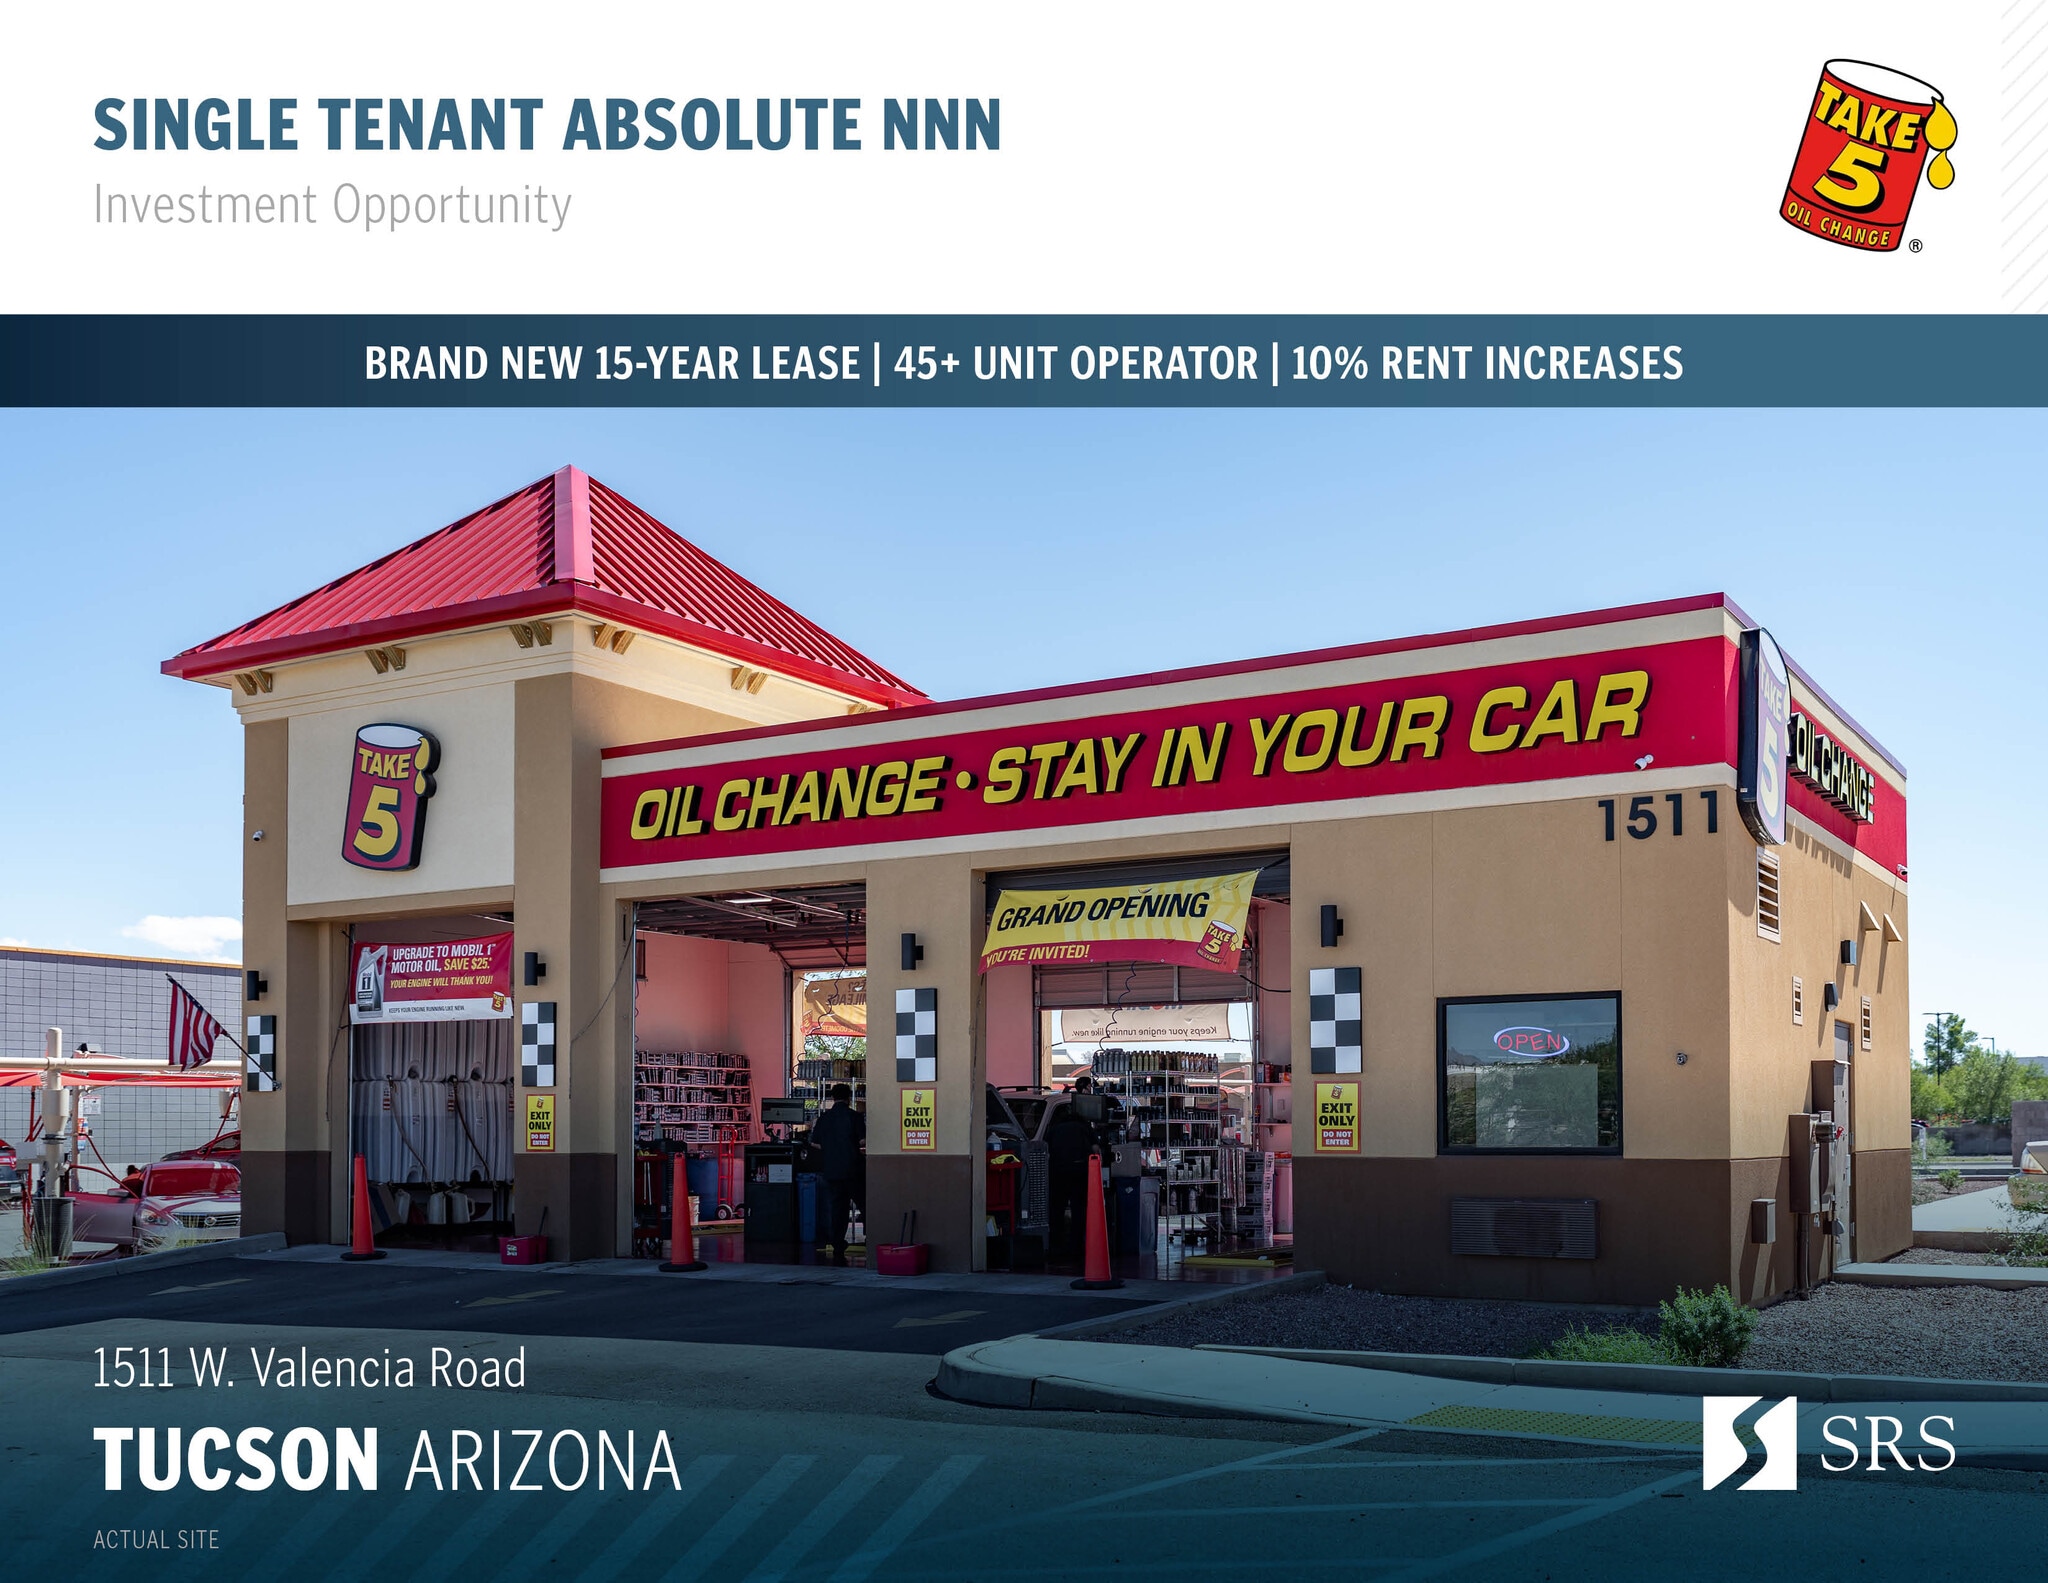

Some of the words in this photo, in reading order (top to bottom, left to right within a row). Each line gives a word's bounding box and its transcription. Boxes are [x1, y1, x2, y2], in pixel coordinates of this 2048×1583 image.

[1759, 661, 1782, 722] TAKE
[358, 747, 412, 780] TAKE
[630, 785, 704, 840] OIL
[712, 755, 948, 832] CHANGE
[982, 732, 1143, 804] STAY
[1152, 722, 1229, 788] IN
[1249, 695, 1450, 776] YOUR
[1468, 670, 1650, 754] CAR
[1760, 716, 1780, 819] 5
[1796, 711, 1819, 784] OIL
[1820, 734, 1875, 825] CHANGE
[353, 784, 402, 858] 5
[1598, 790, 1718, 842] 1511
[996, 900, 1086, 932] GRAND
[1087, 892, 1210, 921] OPENING
[1207, 925, 1231, 943] TAKE
[393, 946, 435, 961] UPGRADE
[436, 945, 449, 958] TO
[450, 944, 484, 957] MOBIL
[1204, 937, 1222, 954] 5
[985, 948, 1028, 968] YOU'RE
[1029, 944, 1090, 961] INVITED!
[391, 960, 423, 974] MOTOR
[425, 959, 442, 973] OIL,
[444, 958, 470, 971] SAVE
[390, 978, 407, 989] YOUR
[407, 977, 433, 988] ENGINE
[433, 976, 449, 987] WILL
[450, 975, 475, 986] THANK
[475, 975, 493, 985] YOU!
[1497, 1033, 1561, 1051] OPEN
[530, 1111, 550, 1120] EXIT
[906, 1107, 930, 1117] EXIT
[1321, 1103, 1353, 1114] EXIT
[529, 1121, 552, 1130] ONLY
[903, 1118, 932, 1128] ONLY
[1318, 1115, 1356, 1126] ONLY
[1325, 1138, 1350, 1146] ENTER
